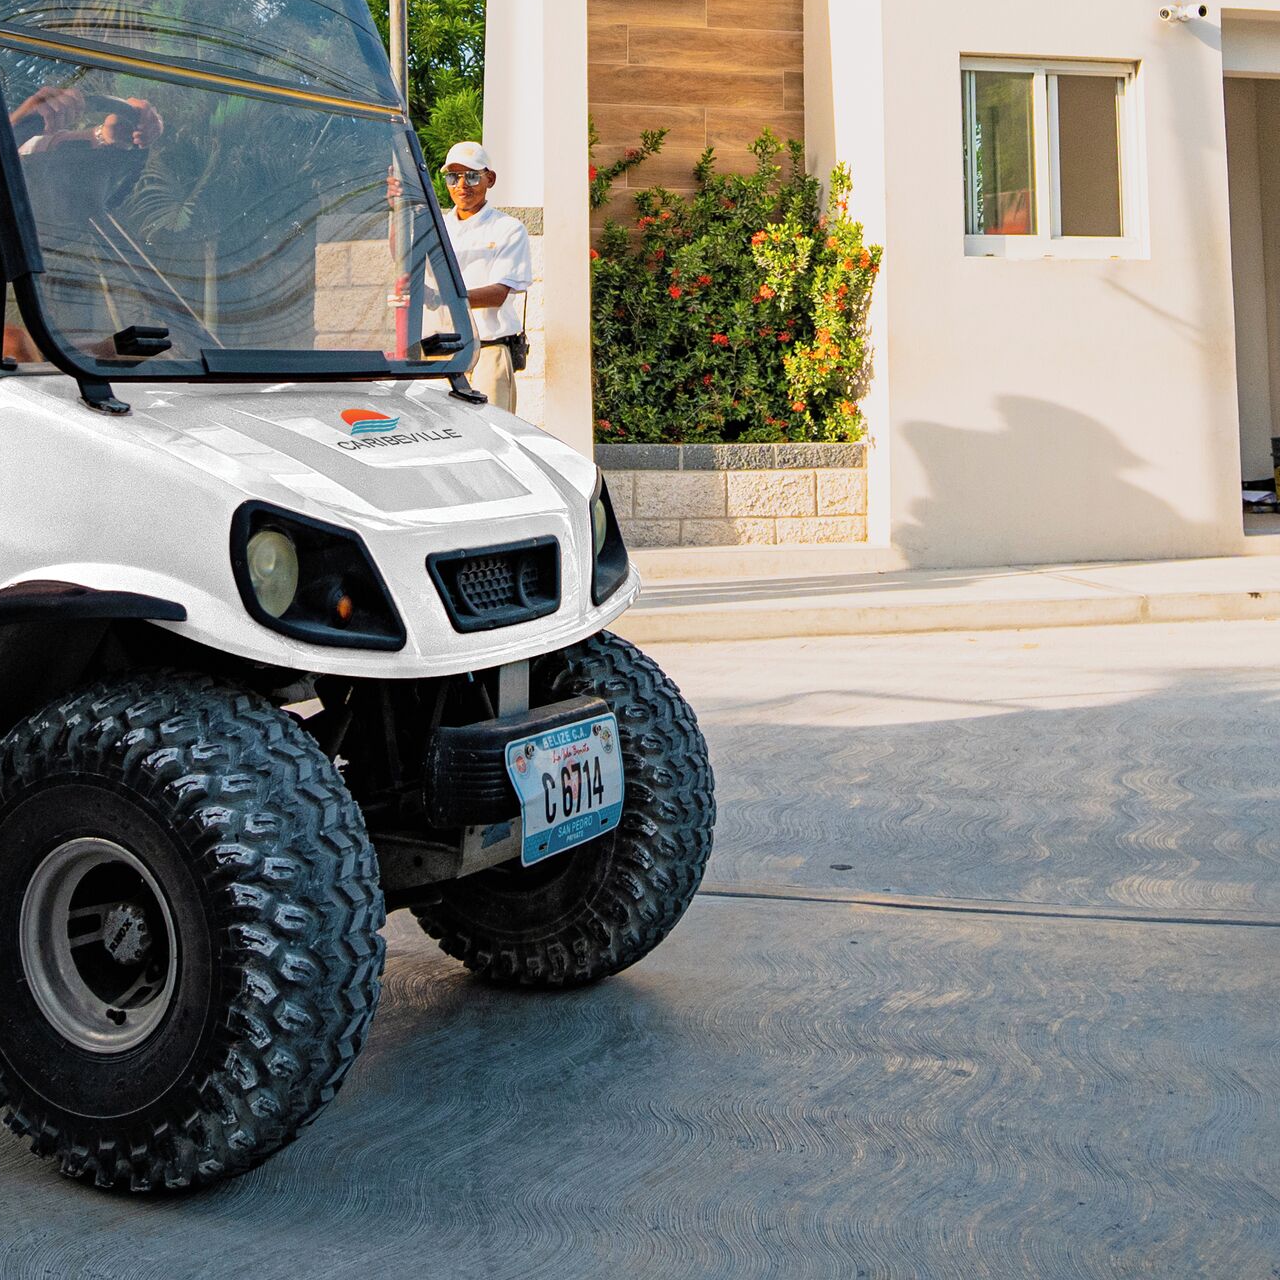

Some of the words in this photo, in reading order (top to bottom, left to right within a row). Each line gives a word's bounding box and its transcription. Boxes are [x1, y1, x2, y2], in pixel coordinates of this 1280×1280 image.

[337, 428, 462, 451] CARIBEVILLE
[542, 730, 571, 750] BELIZE
[542, 772, 557, 824] C
[560, 756, 604, 817] 6714
[557, 824, 571, 838] SAN
[571, 815, 593, 832] PEDRO
